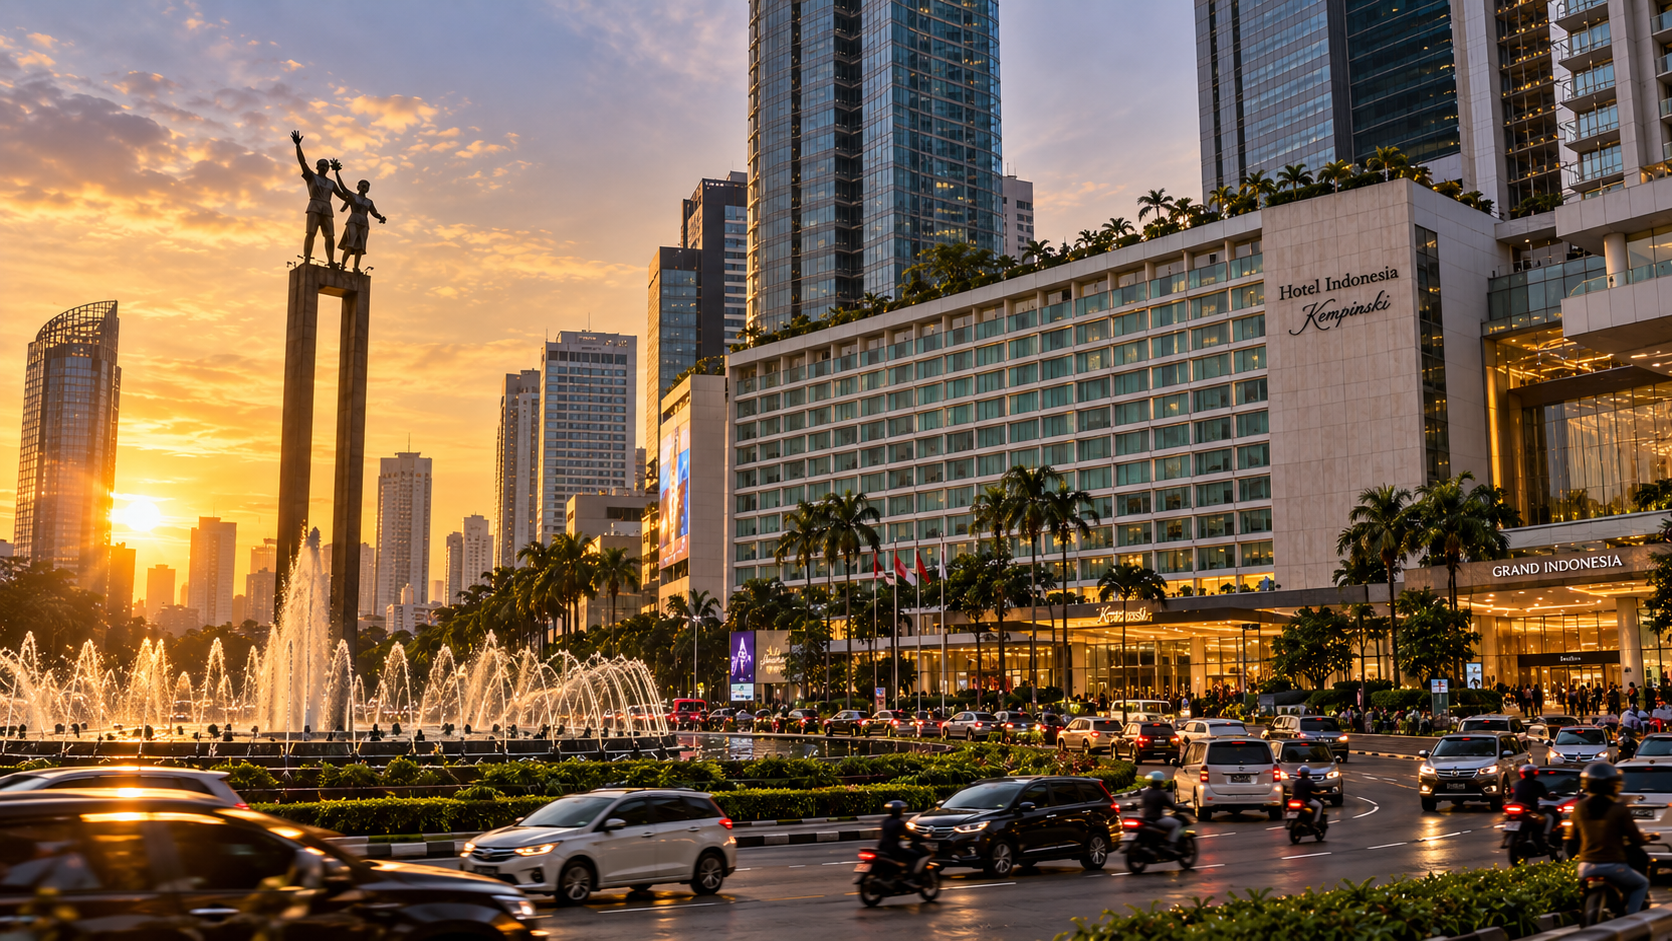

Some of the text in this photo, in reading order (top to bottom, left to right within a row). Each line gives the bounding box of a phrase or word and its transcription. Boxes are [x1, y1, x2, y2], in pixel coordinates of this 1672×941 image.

[1279, 266, 1399, 300] Hotel Indonesia
[1288, 290, 1391, 336] Kempinski
[1492, 554, 1623, 577] GRAND INDONESIA
